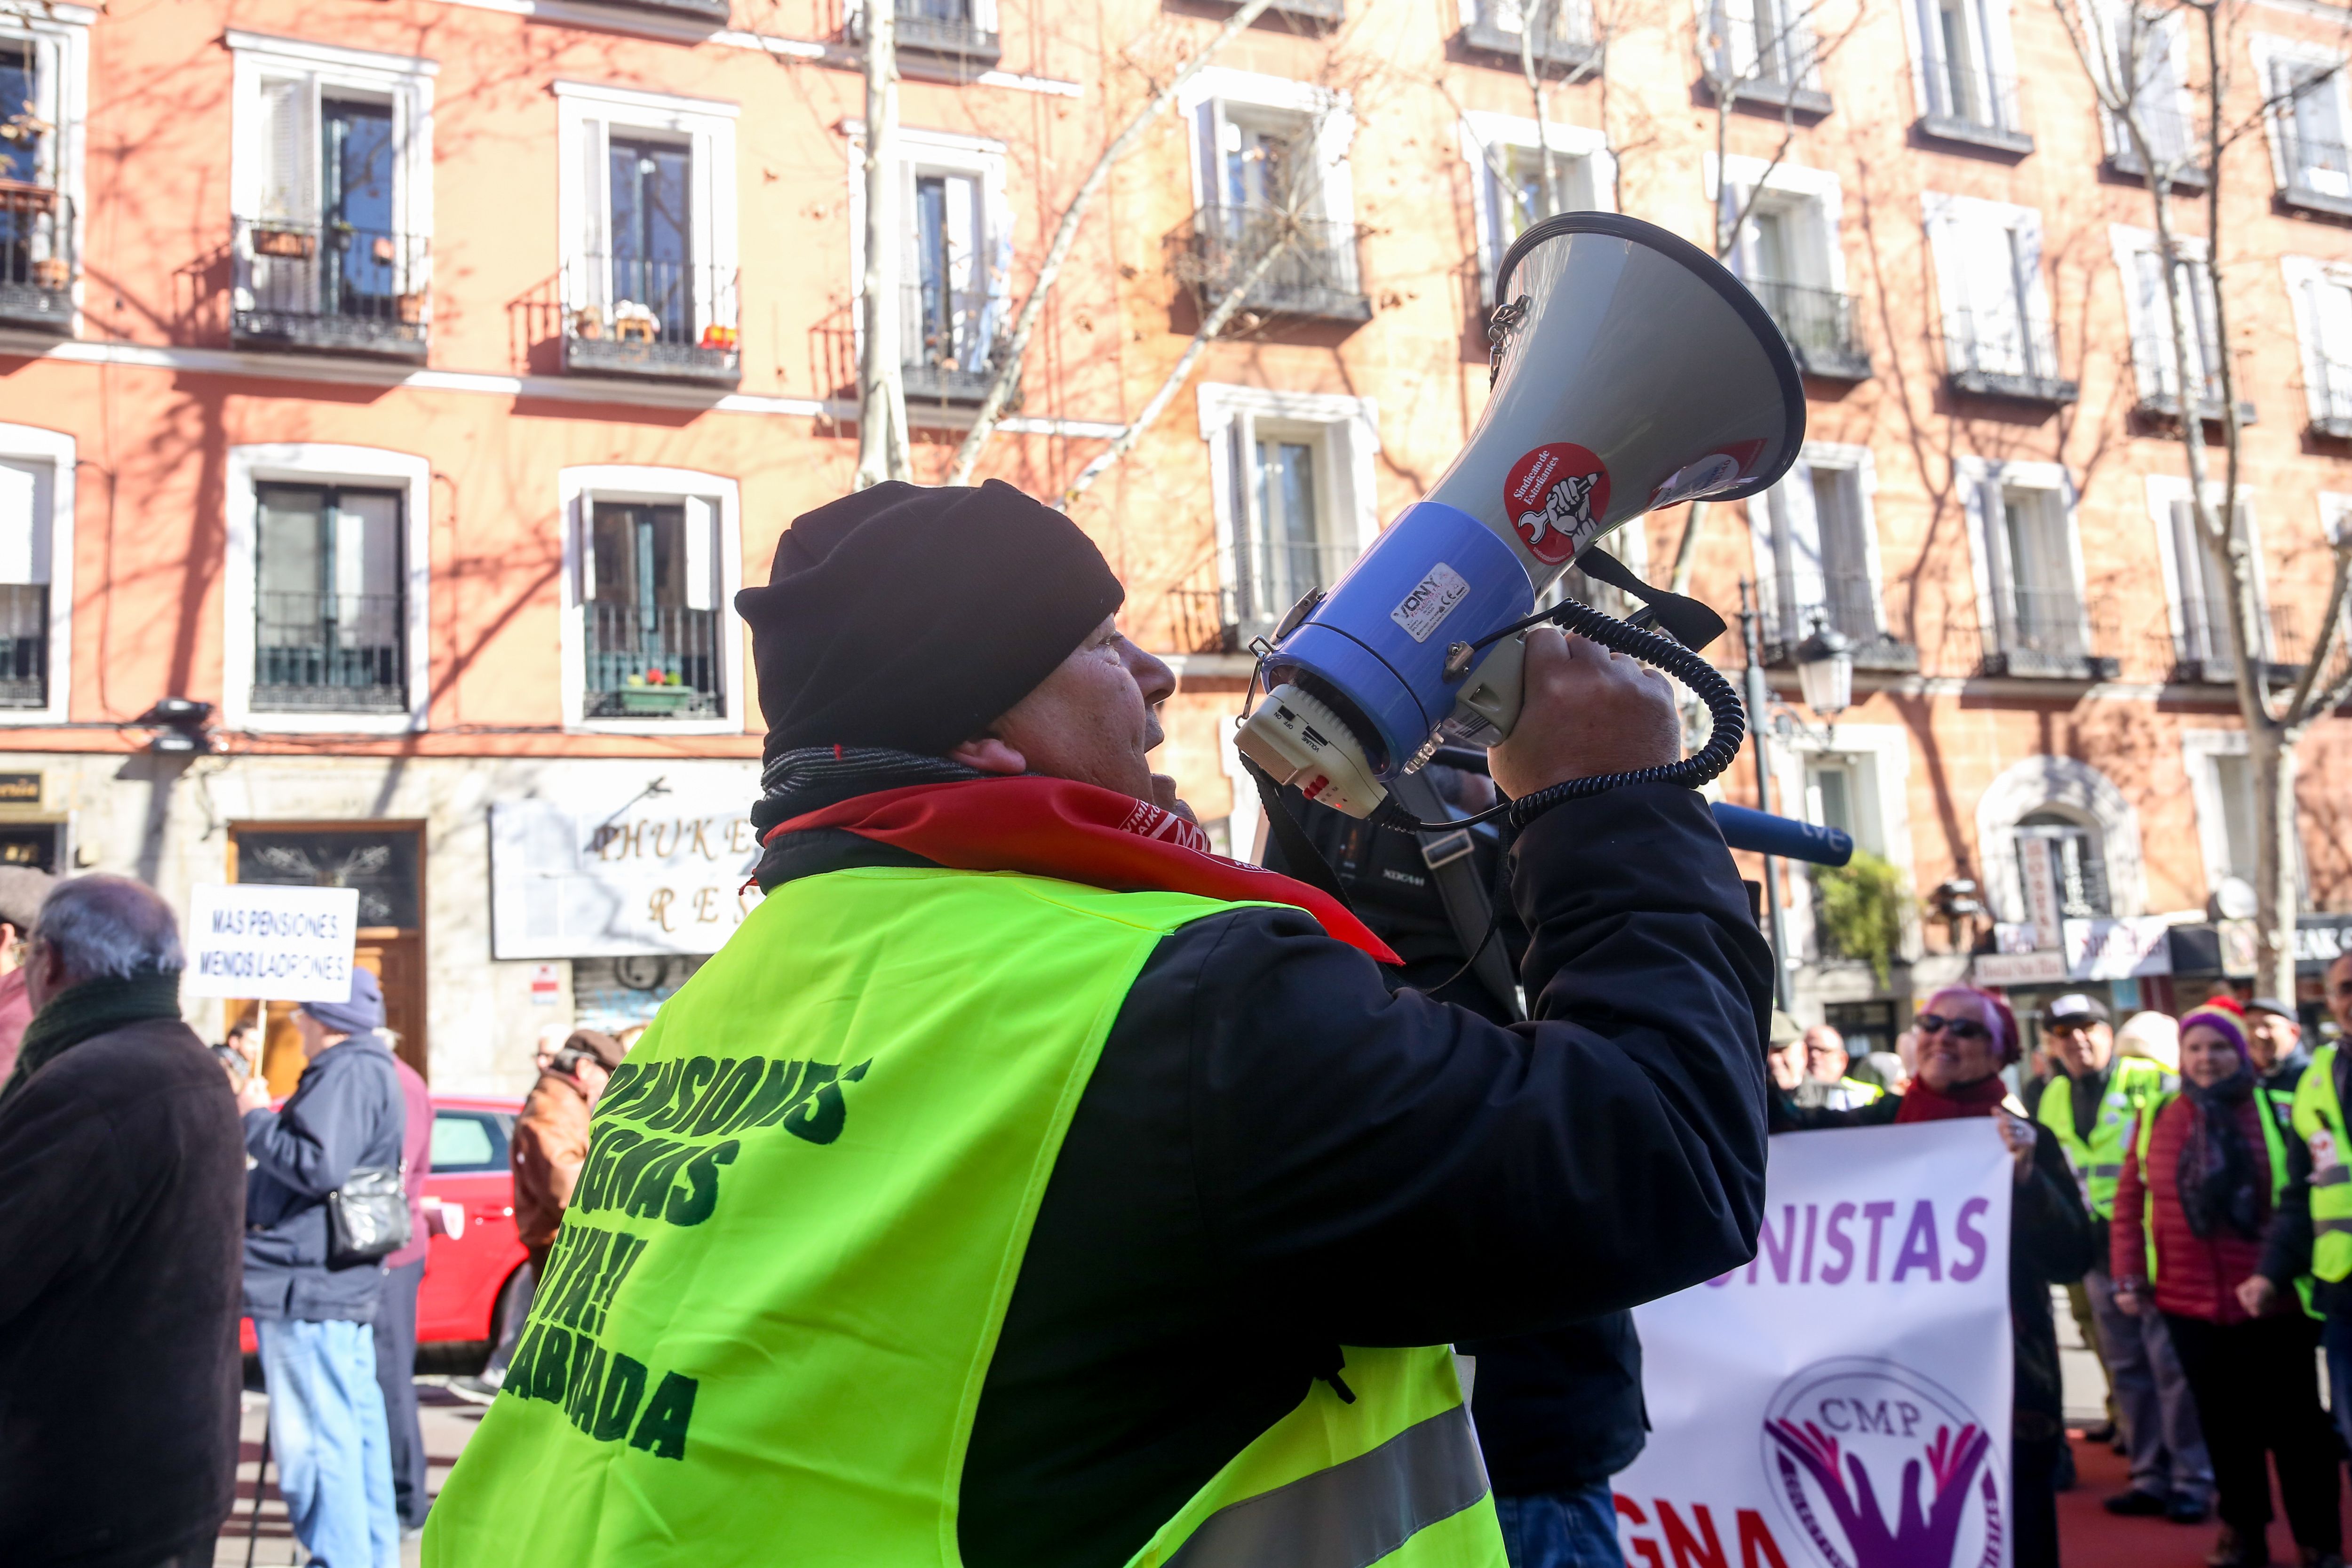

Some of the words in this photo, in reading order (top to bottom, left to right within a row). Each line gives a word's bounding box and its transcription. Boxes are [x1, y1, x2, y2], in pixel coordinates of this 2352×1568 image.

[1513, 461, 1543, 500] Sindicato
[1539, 450, 1550, 462] de
[1523, 456, 1559, 505] Estudiantes
[1393, 574, 1438, 619] VONY
[1283, 721, 1294, 730] OFF
[1301, 735, 1319, 753] VOLUME
[248, 909, 338, 939] PENSIONES
[199, 950, 254, 977] MENOS
[257, 951, 345, 980] LADRONES
[590, 1055, 874, 1145] PENSIONES
[1704, 1196, 1989, 1288] NISTAS
[502, 1317, 699, 1460] ABRADA
[1819, 1398, 1921, 1438] CMP
